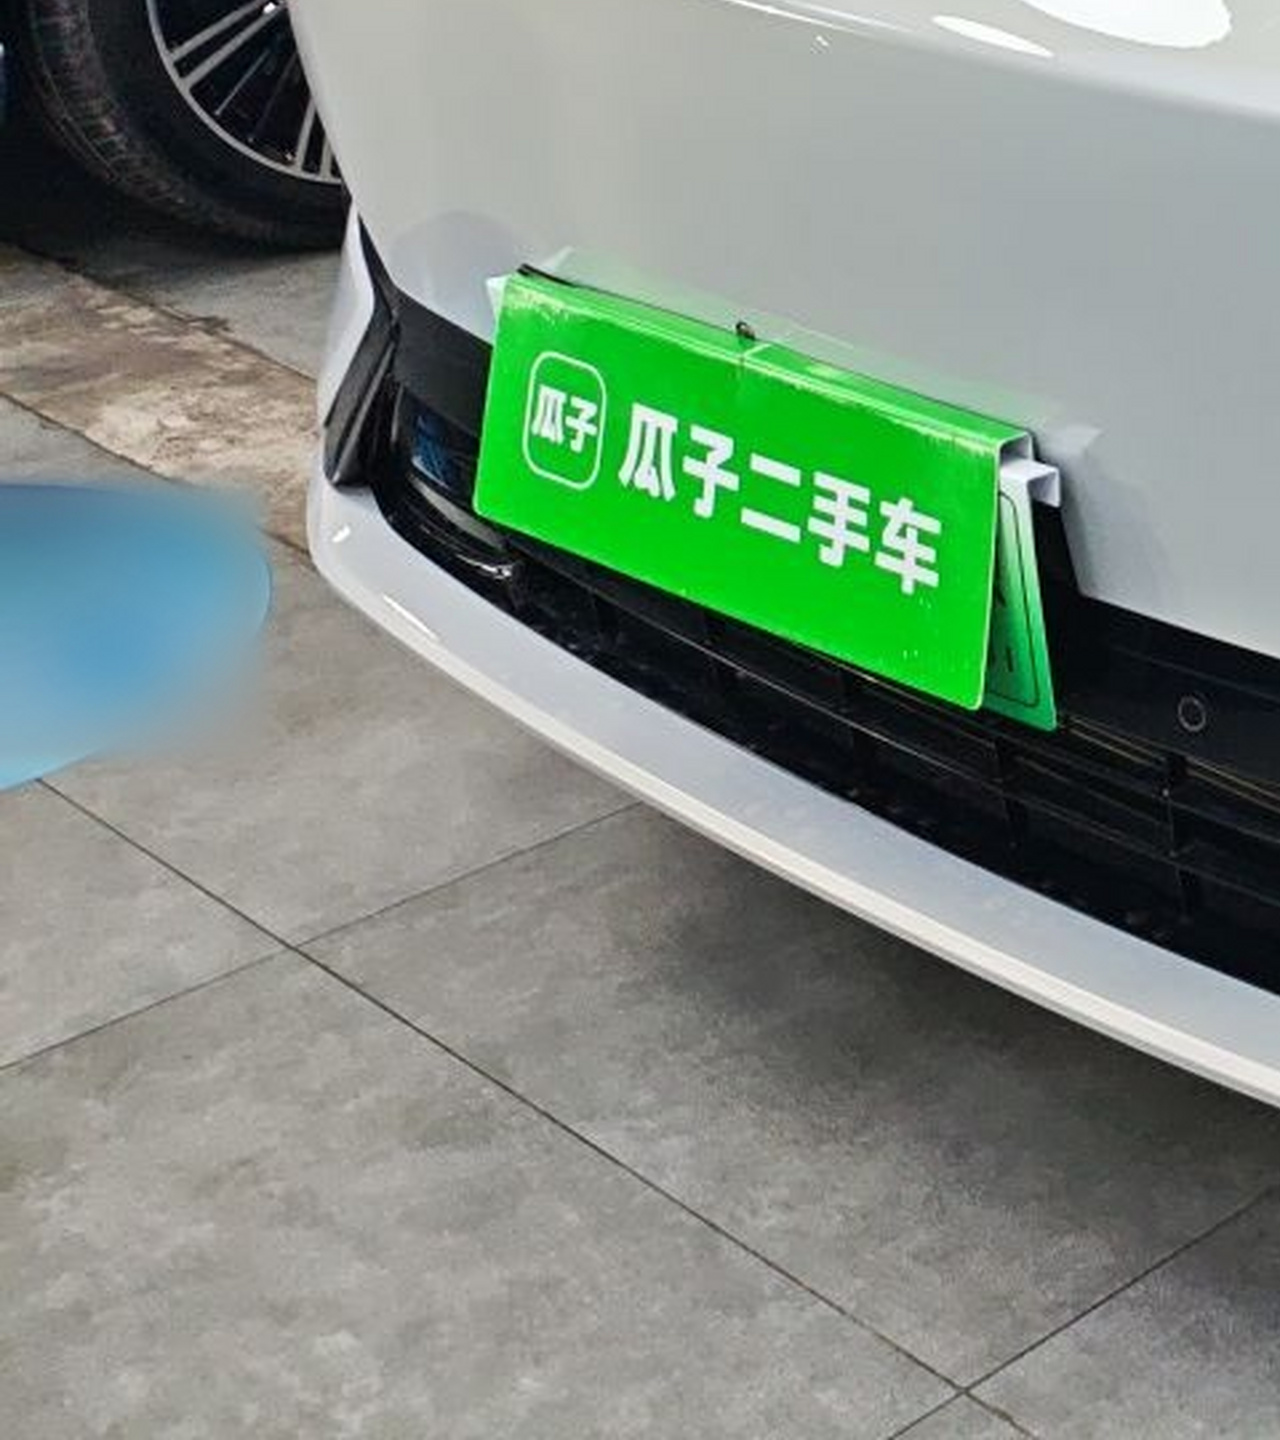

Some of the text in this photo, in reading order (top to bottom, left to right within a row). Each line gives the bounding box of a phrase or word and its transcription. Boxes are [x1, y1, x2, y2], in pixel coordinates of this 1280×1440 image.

[531, 385, 598, 452] 瓜子
[618, 403, 941, 595] 瓜子二手车
